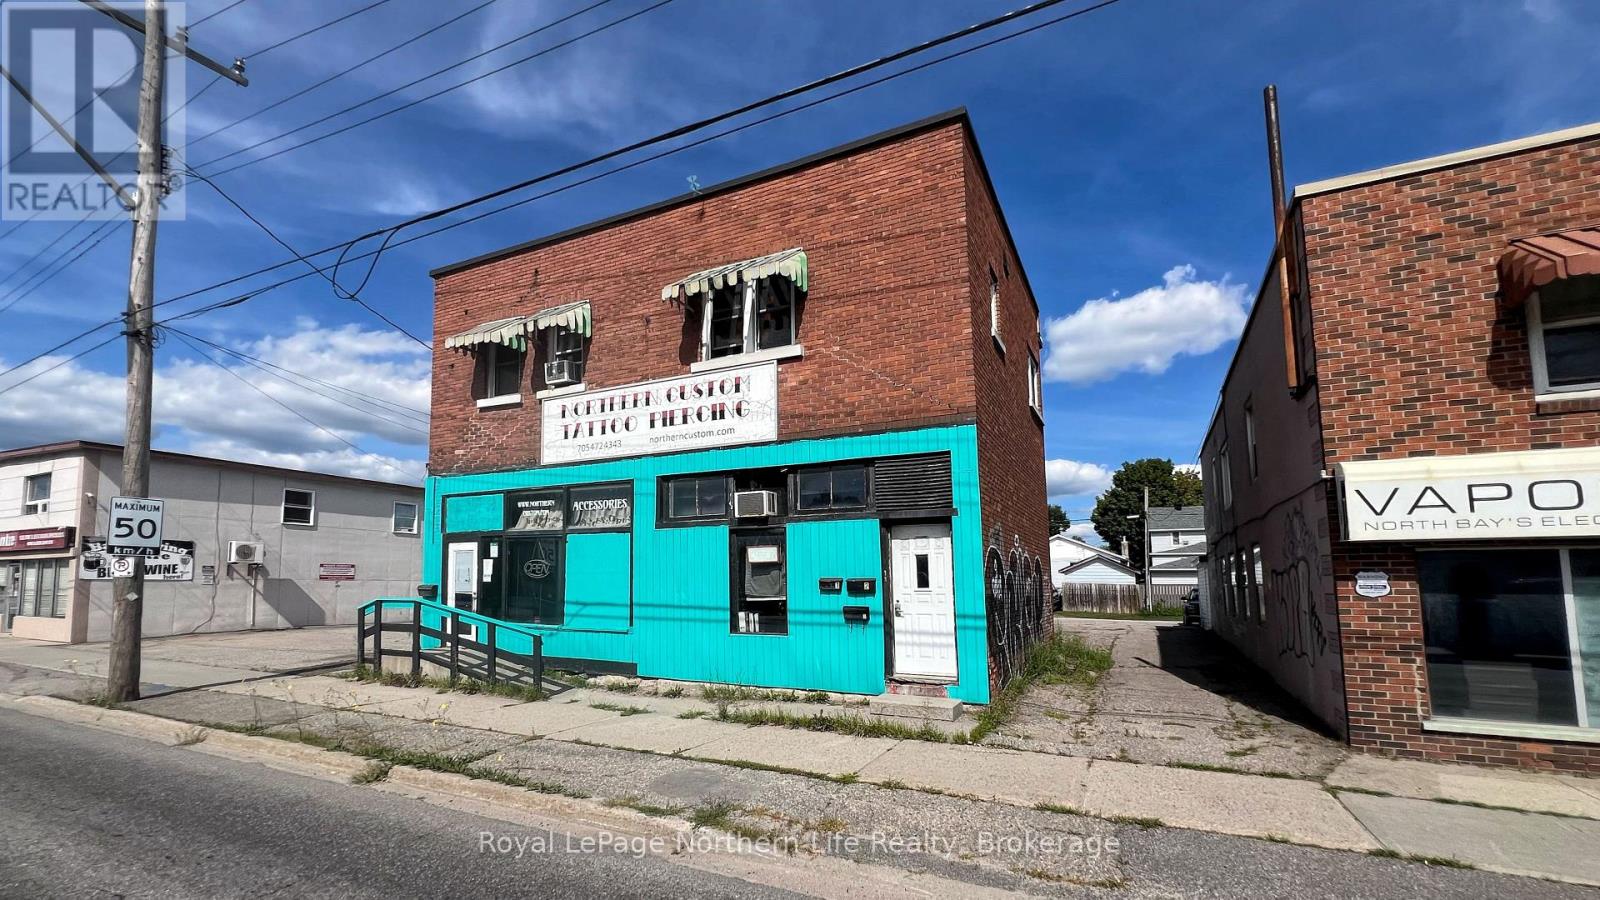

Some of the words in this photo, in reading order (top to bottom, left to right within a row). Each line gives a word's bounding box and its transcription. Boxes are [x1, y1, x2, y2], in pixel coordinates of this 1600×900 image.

[561, 389, 660, 419] NORTHERN
[666, 375, 750, 403] CUSTOM
[560, 416, 638, 439] TATTOO
[650, 400, 750, 429] PIERCING
[649, 427, 735, 443] northerncustom.com
[572, 498, 628, 511] ACCESSORIES
[1354, 479, 1584, 516] VAPO
[114, 502, 160, 513] MAXIMUM
[114, 517, 157, 539] 50
[1364, 519, 1447, 531] NORTH
[1456, 517, 1532, 529] BAY'S
[113, 546, 154, 555] km/h
[144, 564, 178, 576] WINE
[526, 563, 550, 575] OPEN
